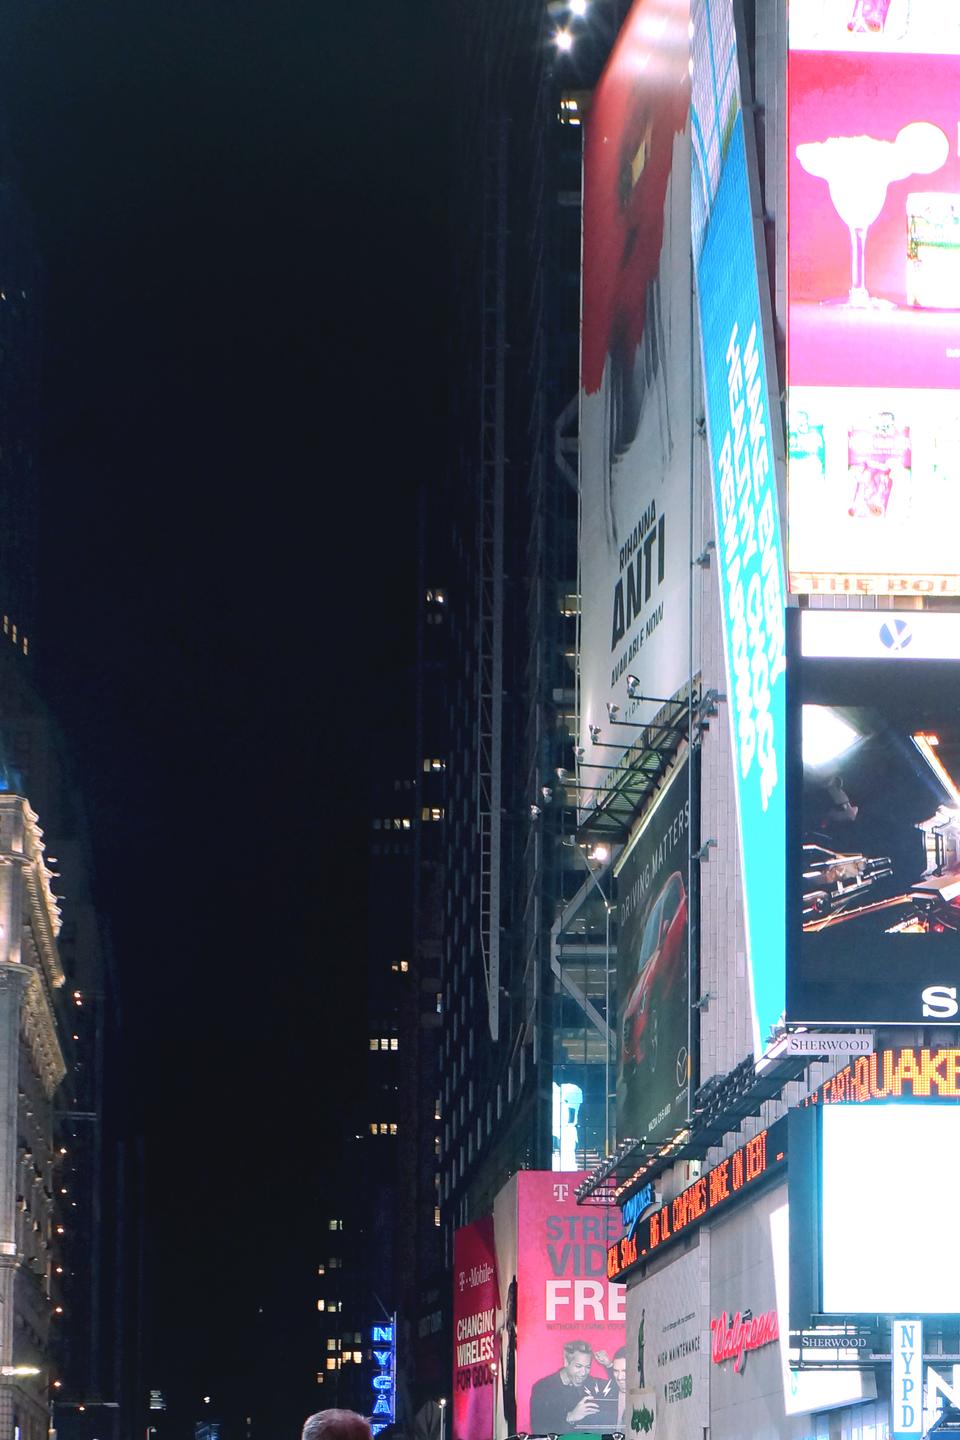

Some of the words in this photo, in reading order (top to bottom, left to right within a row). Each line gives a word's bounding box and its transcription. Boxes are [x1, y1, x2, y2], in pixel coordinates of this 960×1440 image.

[619, 498, 657, 574] RIHANNA
[611, 512, 665, 652] ANTI
[805, 577, 874, 592] THE
[620, 873, 651, 928] DRIVING
[651, 800, 690, 874] MATTERS
[790, 1038, 870, 1051] SHERWOOD
[711, 1310, 779, 1373] Walgreens
[801, 1337, 867, 1348] SHERWOOD
[901, 1325, 915, 1428] NYPD
